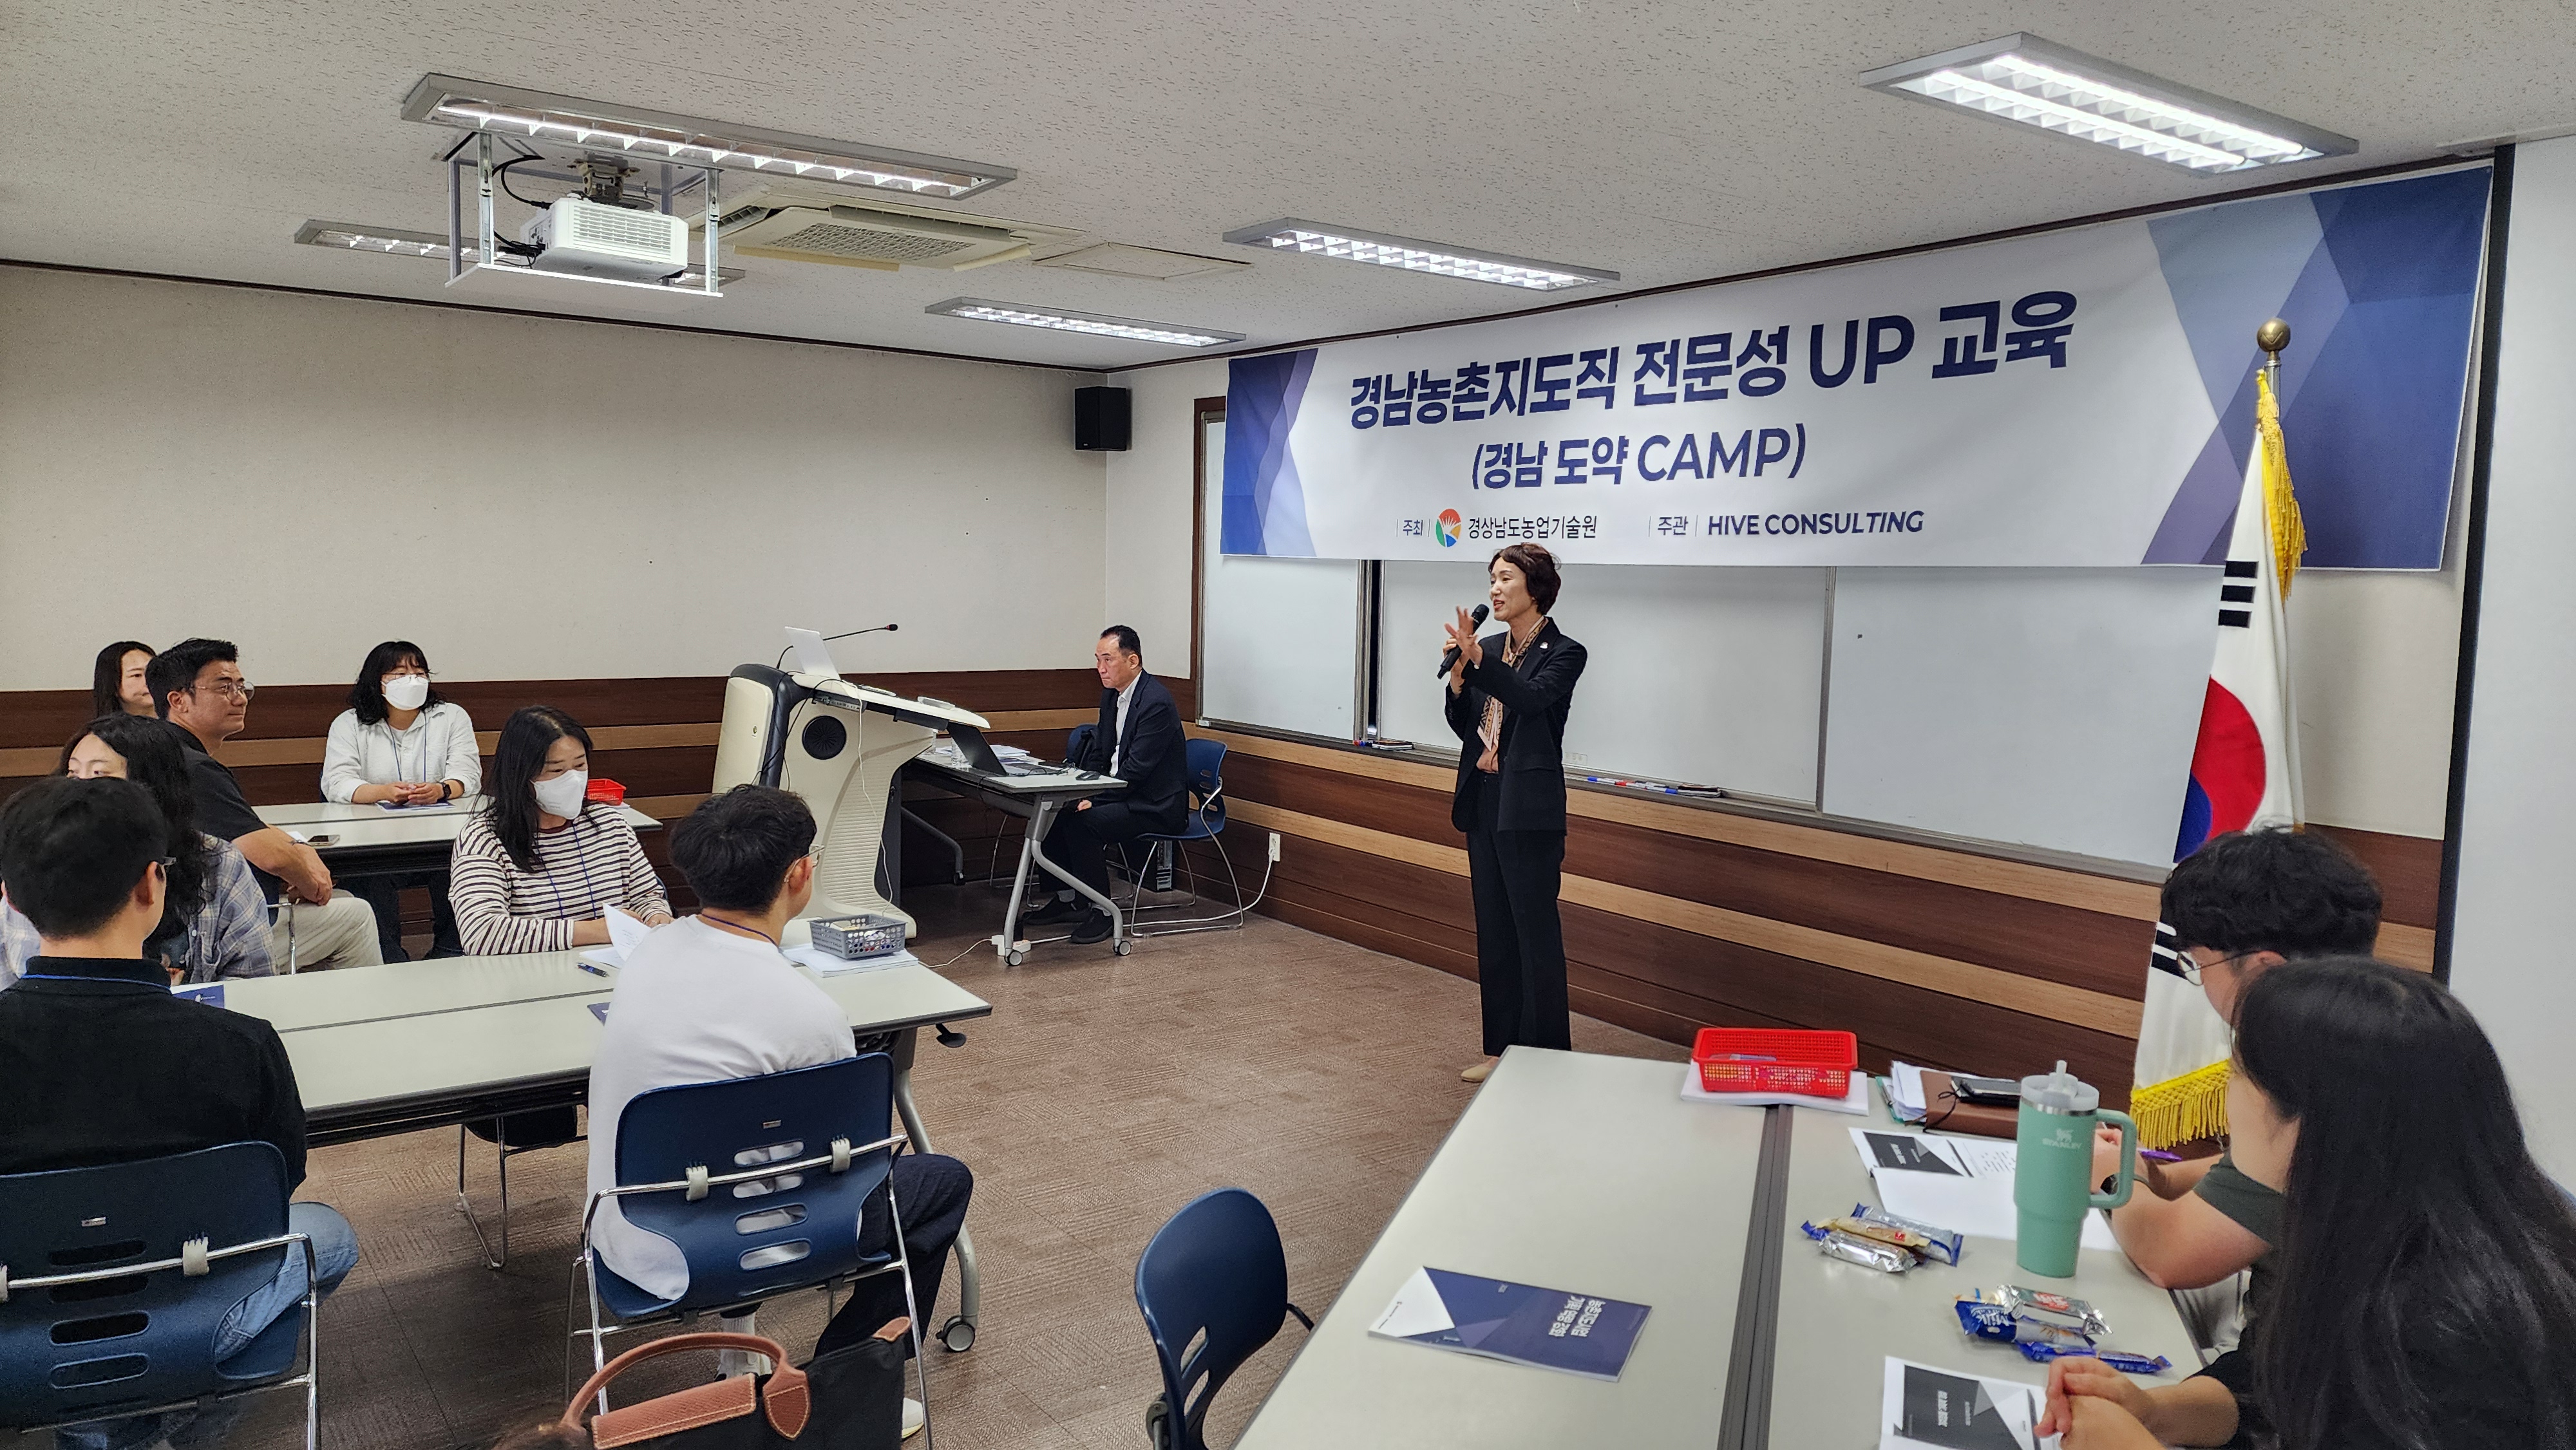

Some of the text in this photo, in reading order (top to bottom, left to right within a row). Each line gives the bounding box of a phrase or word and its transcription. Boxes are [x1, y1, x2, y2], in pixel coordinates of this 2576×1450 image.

[1350, 290, 2078, 429] 경남농촌지도직 전문성 UP 교육
[1472, 423, 1806, 490] (경남 도약 CAMP)
[1403, 519, 1423, 536] 주최
[1468, 515, 1597, 540] 경상남도농업기술원
[1657, 516, 1689, 536] 주관
[1708, 511, 1925, 535] HIVE CONSULTING
[1976, 1313, 2010, 1326] Milk
